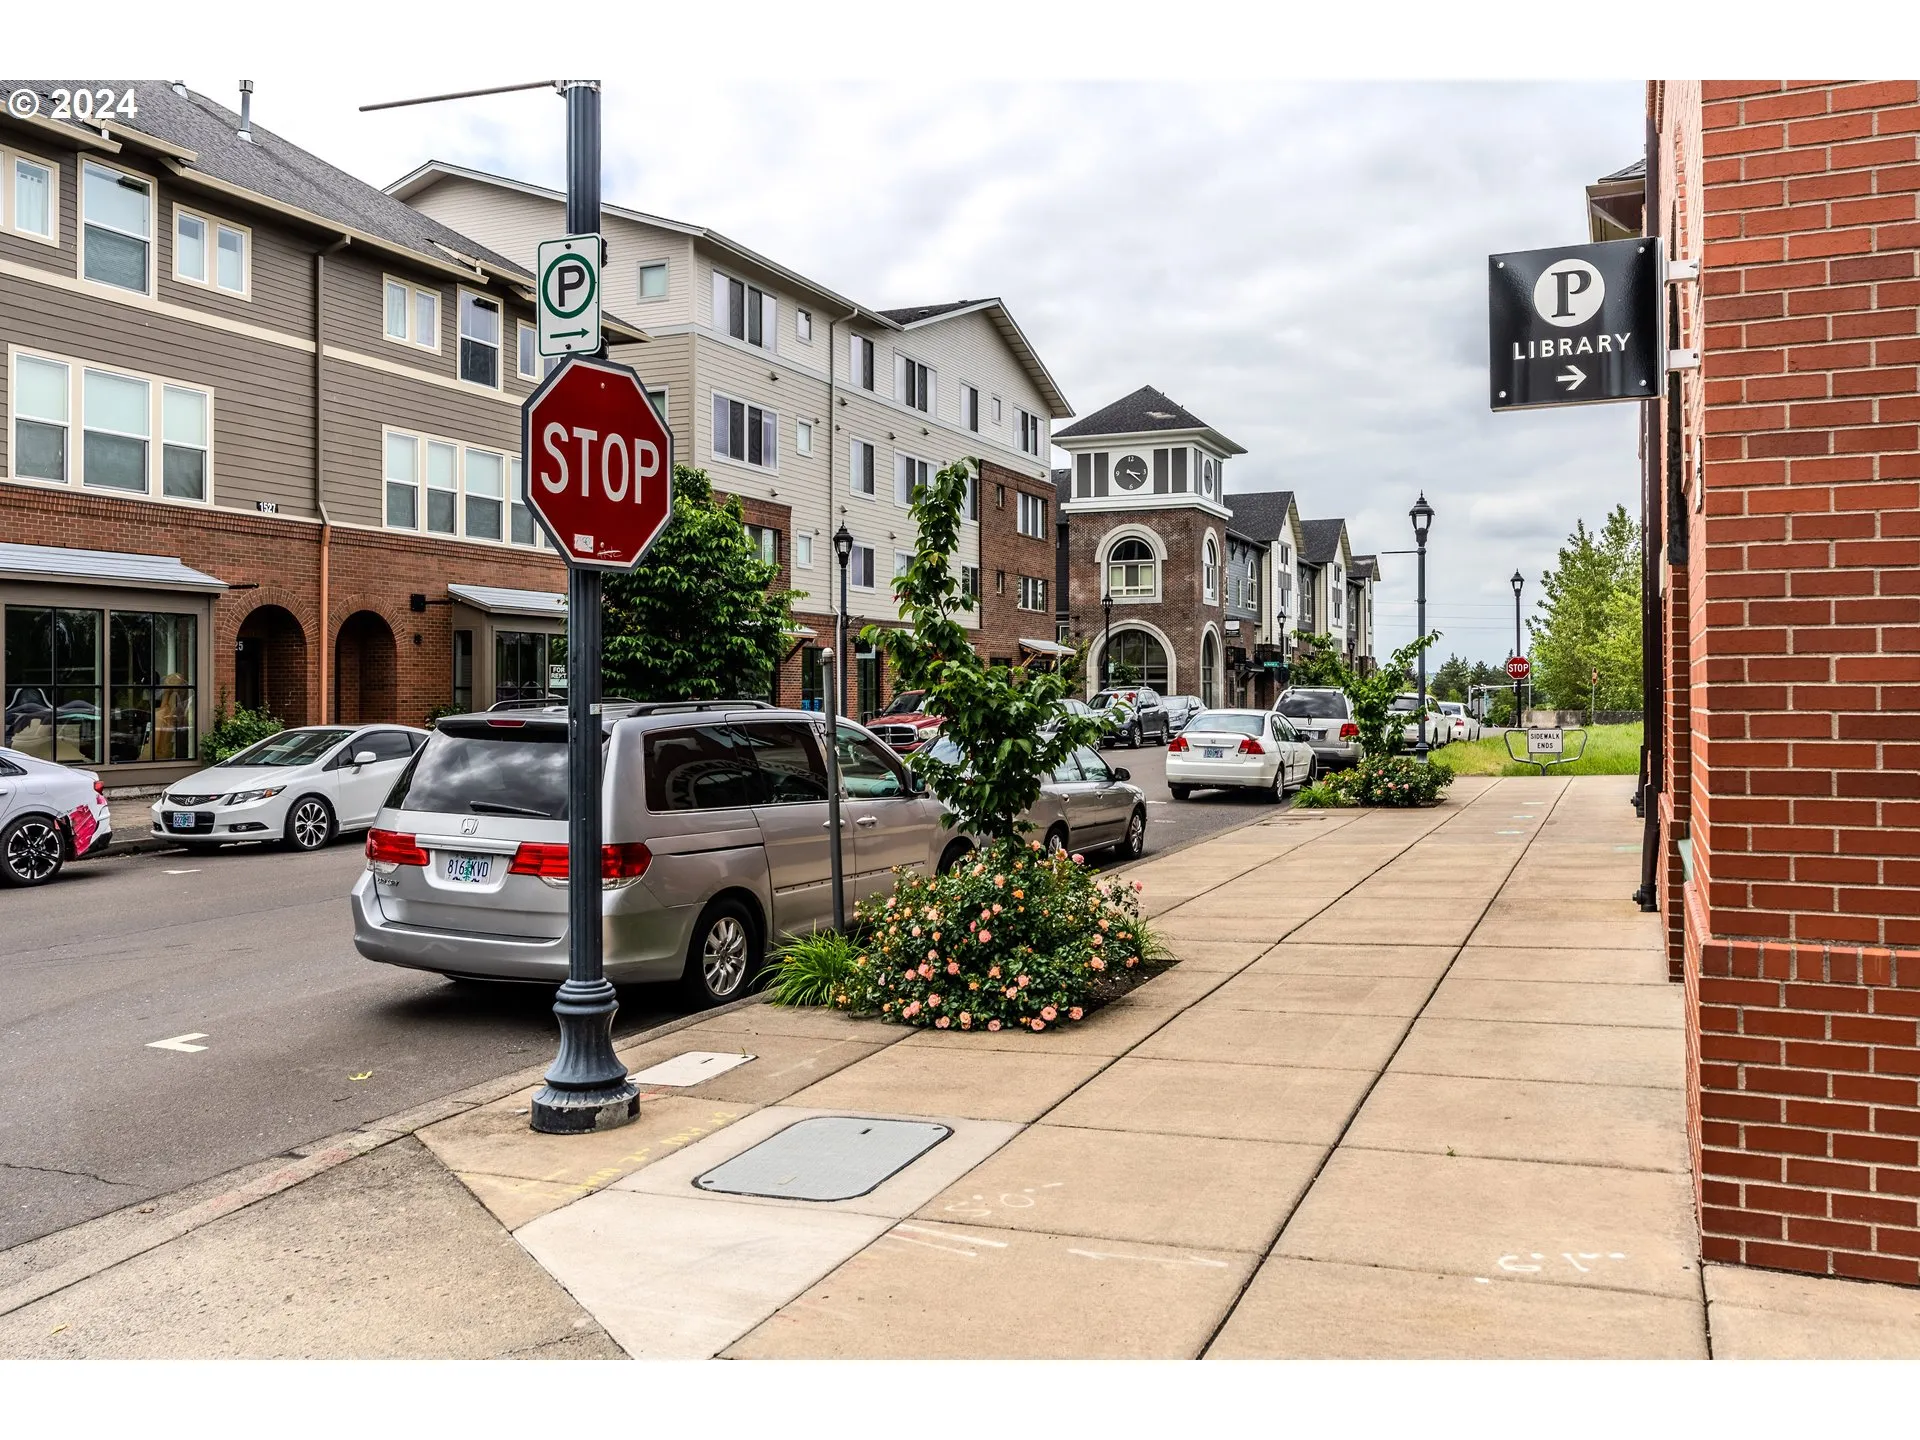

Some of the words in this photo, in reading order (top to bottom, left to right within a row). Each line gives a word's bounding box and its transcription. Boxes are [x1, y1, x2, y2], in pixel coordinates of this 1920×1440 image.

[558, 264, 586, 308] P
[1551, 269, 1592, 318] P
[1512, 332, 1631, 361] LIBRARY
[540, 421, 660, 505] STOP
[259, 502, 276, 513] 1527
[1508, 663, 1529, 673] STOP
[447, 859, 466, 875] 816
[469, 860, 489, 877] KVD
